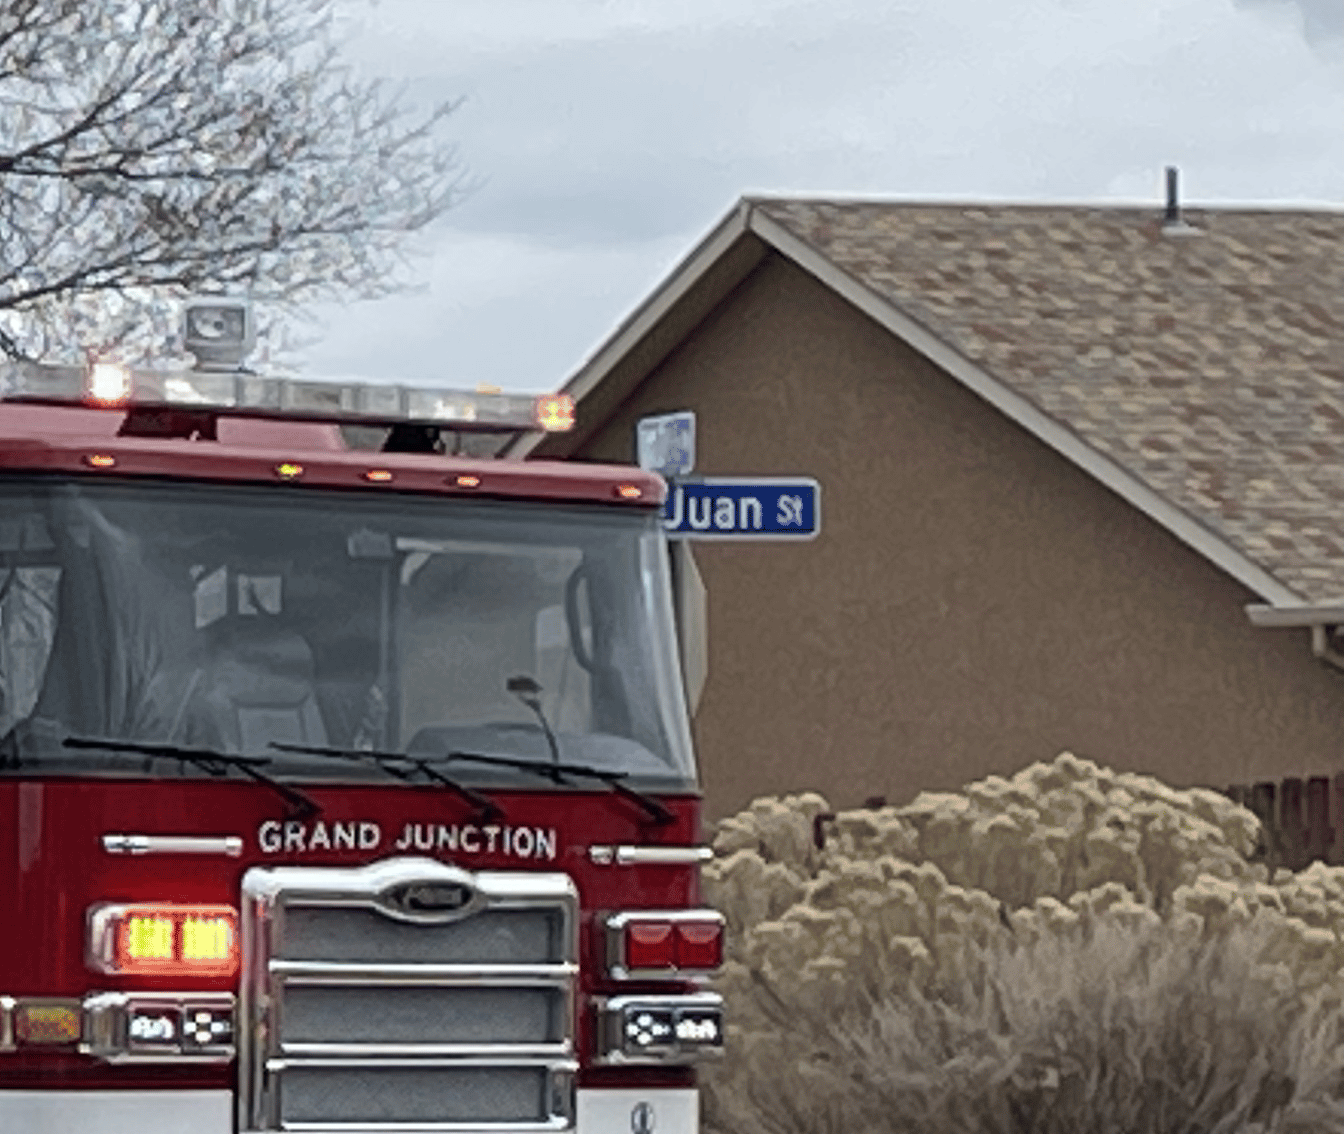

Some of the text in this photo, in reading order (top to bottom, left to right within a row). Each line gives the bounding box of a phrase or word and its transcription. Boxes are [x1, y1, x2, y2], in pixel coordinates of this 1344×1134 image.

[663, 487, 803, 530] Juan St
[258, 820, 557, 860] GRAND JUNCTION
